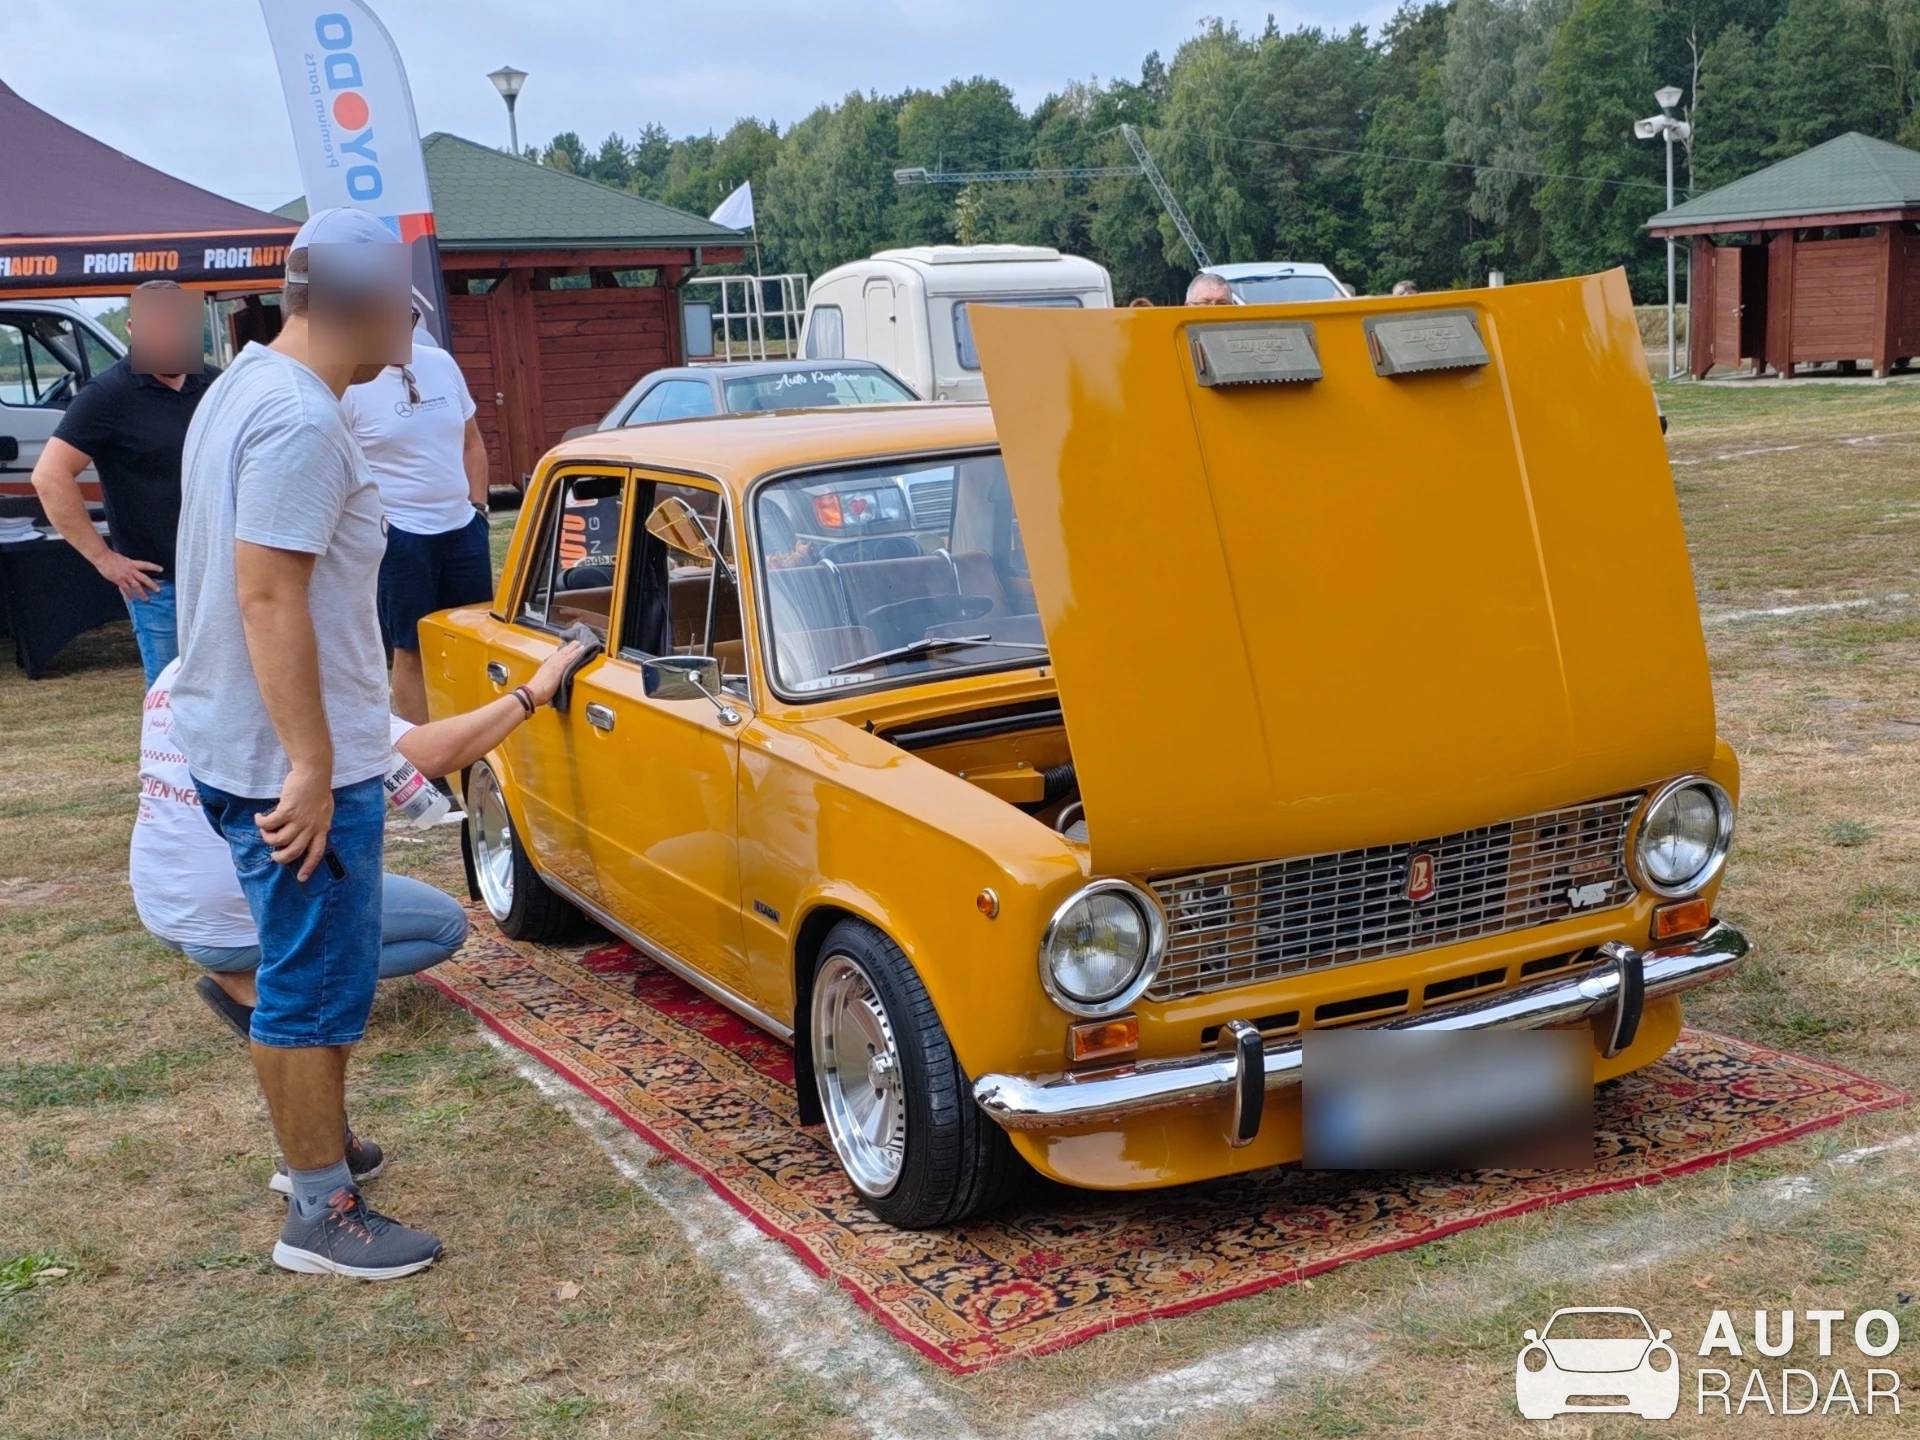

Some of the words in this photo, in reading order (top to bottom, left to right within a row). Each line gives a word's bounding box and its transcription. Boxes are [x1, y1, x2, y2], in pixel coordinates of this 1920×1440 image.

[83, 250, 179, 274] PROFIAUTO
[776, 373, 807, 390] Auto
[384, 778, 398, 793] BE
